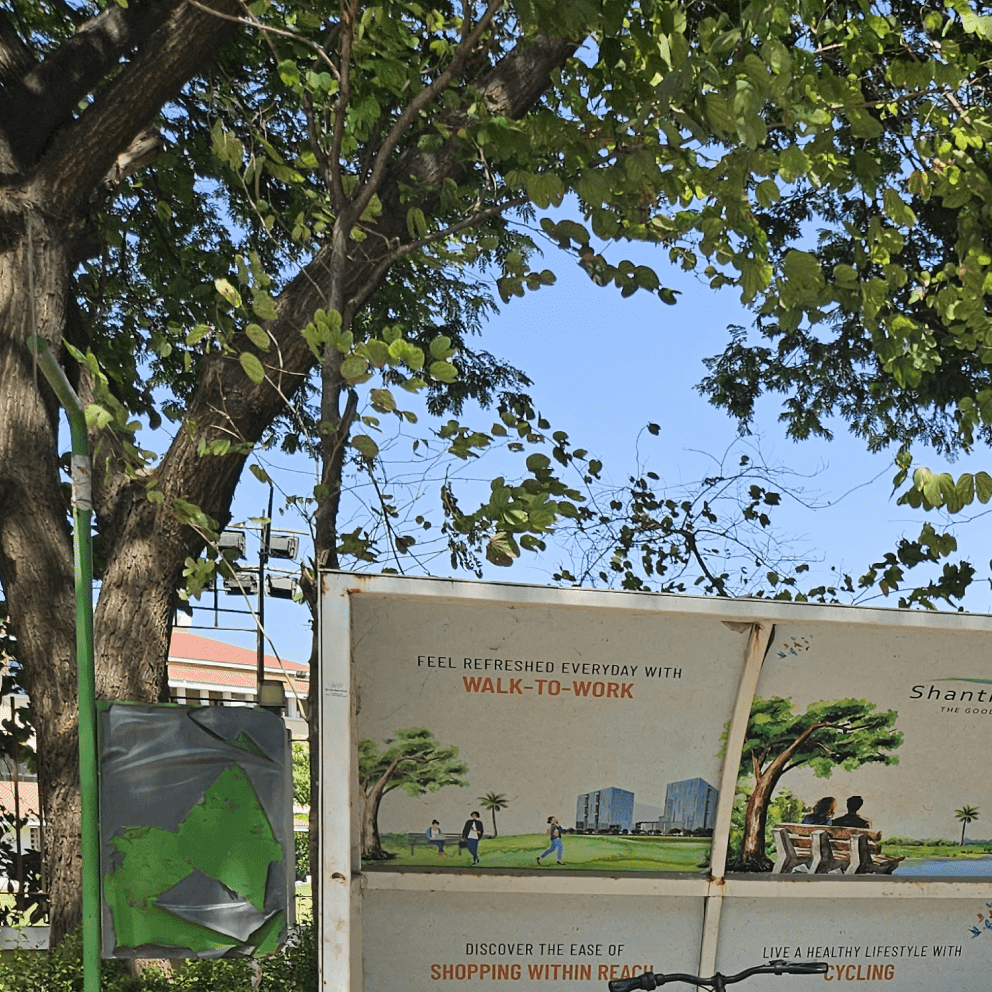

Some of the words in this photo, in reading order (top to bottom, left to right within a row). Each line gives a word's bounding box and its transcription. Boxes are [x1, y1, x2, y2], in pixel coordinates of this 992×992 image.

[417, 655, 457, 669] FEEL
[463, 658, 555, 673] REFRESHED
[561, 662, 638, 677] EVERYDAY
[645, 666, 683, 679] WITH
[462, 676, 635, 699] WALK-TO-WORK
[465, 943, 534, 956] DISCOVER
[539, 943, 564, 956] THE
[570, 944, 602, 956] EASE
[608, 944, 625, 956] OF
[763, 946, 790, 959] LIVE
[794, 946, 802, 958] A
[807, 946, 861, 958] HEALTHY
[865, 945, 928, 958] LIFESTYLE
[933, 945, 963, 957] WITH
[430, 963, 522, 981] SHOPPING
[528, 964, 592, 981] WITHIN
[823, 964, 895, 981] CYCLING
